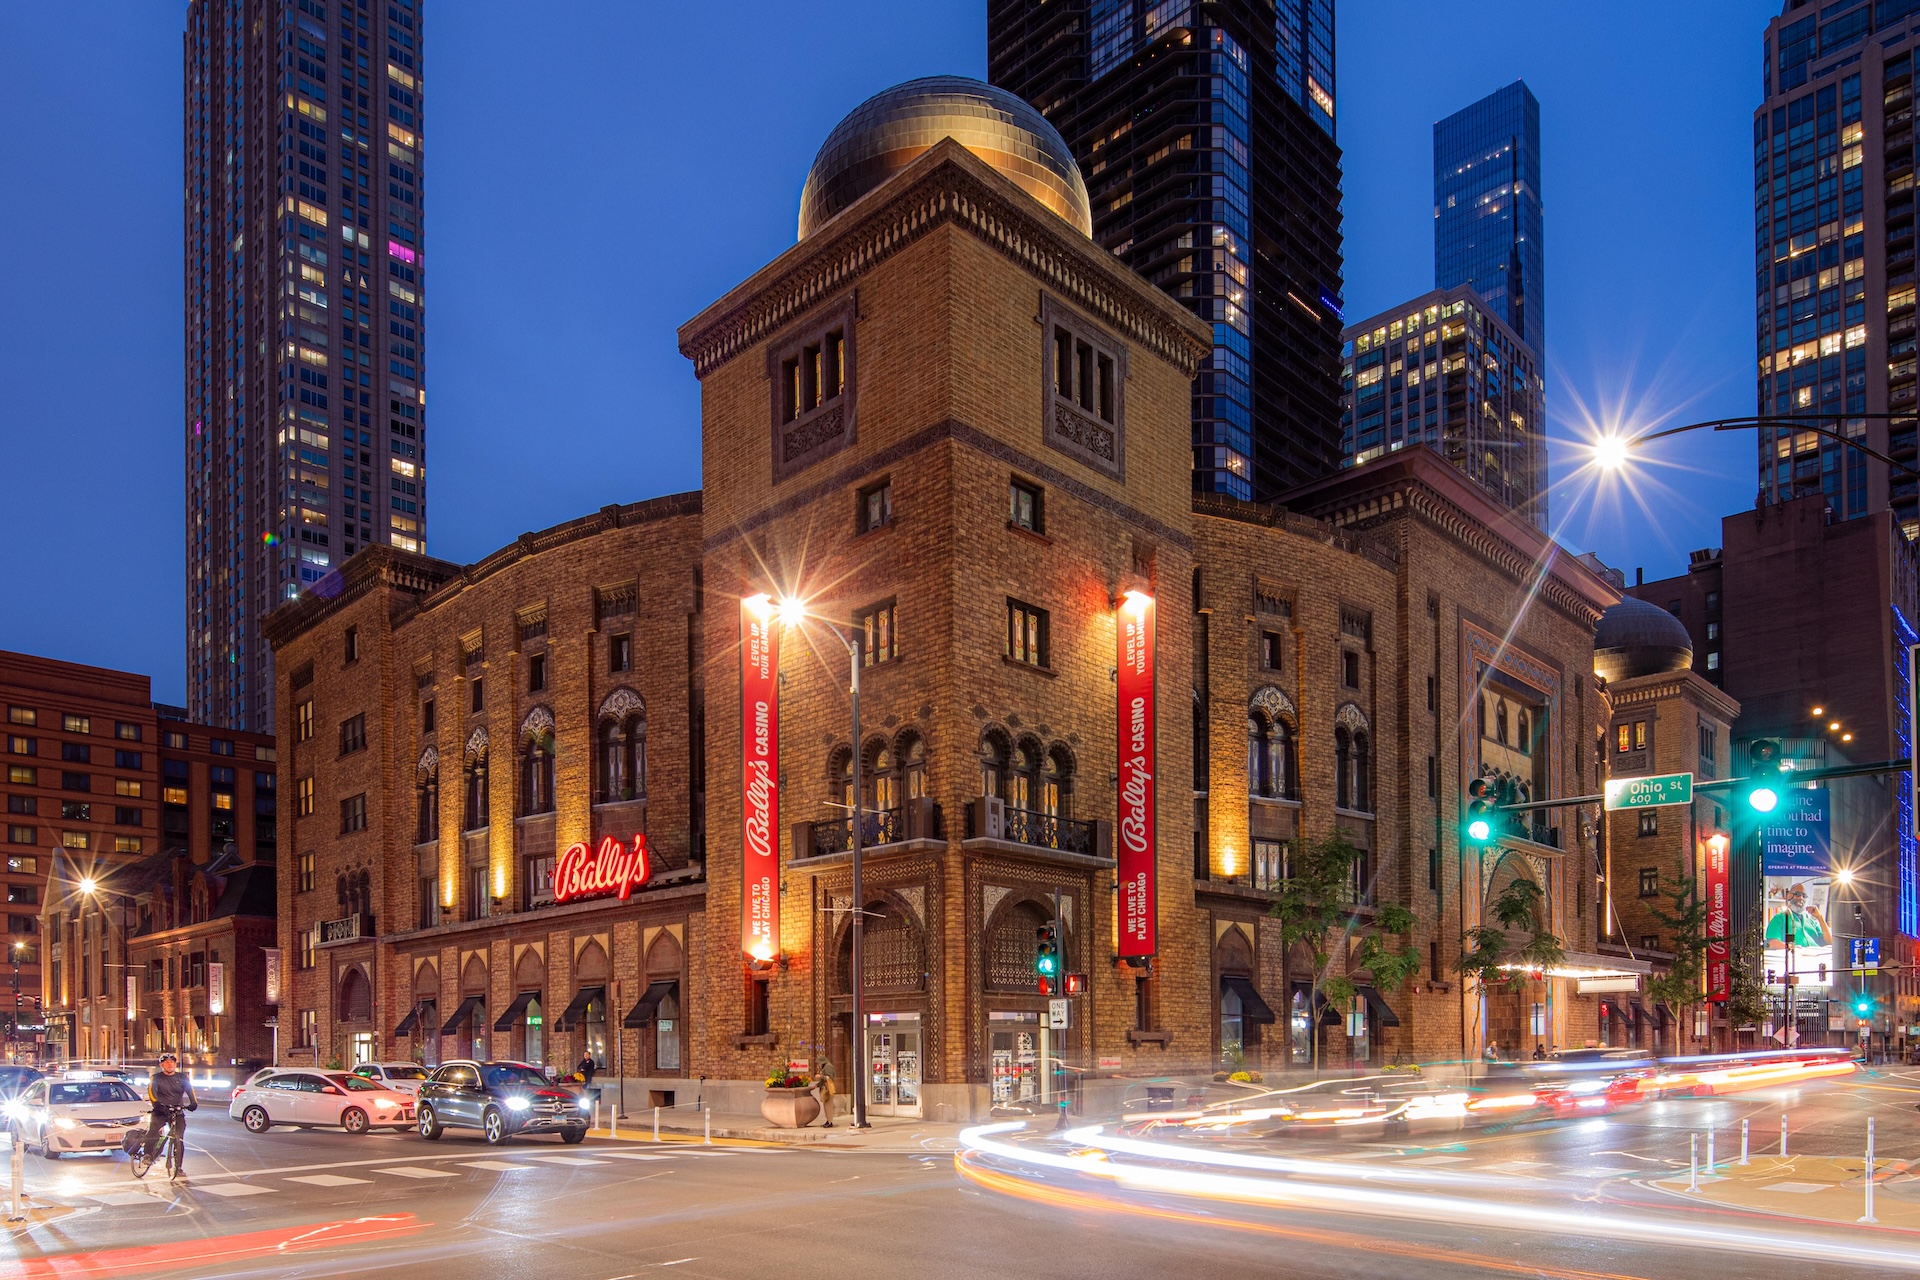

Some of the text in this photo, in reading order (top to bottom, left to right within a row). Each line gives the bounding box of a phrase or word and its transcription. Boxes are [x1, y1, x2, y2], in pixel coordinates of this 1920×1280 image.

[751, 623, 760, 667] LEVEL UP
[760, 617, 769, 679] YOUR GAMI
[1126, 624, 1136, 666] LEVEL UP
[1136, 648, 1145, 676] YOUR
[746, 701, 776, 857] Bally's CASINO
[1122, 697, 1152, 852] Bally's CASINO
[1630, 781, 1682, 794] Ohio St
[1630, 793, 1666, 804] 600 N
[1800, 808, 1822, 822] had
[1767, 824, 1808, 837] time to
[1767, 841, 1815, 858] imagine.
[554, 834, 647, 900] Bally's
[752, 884, 760, 935] WE LIVE TO
[762, 876, 770, 944] PLAY CHICAGO
[1128, 882, 1136, 933] WE LIVE TO
[1138, 872, 1146, 940] PLAY CHICAGO
[1715, 883, 1724, 908] CASINO
[268, 956, 276, 982] ROOM
